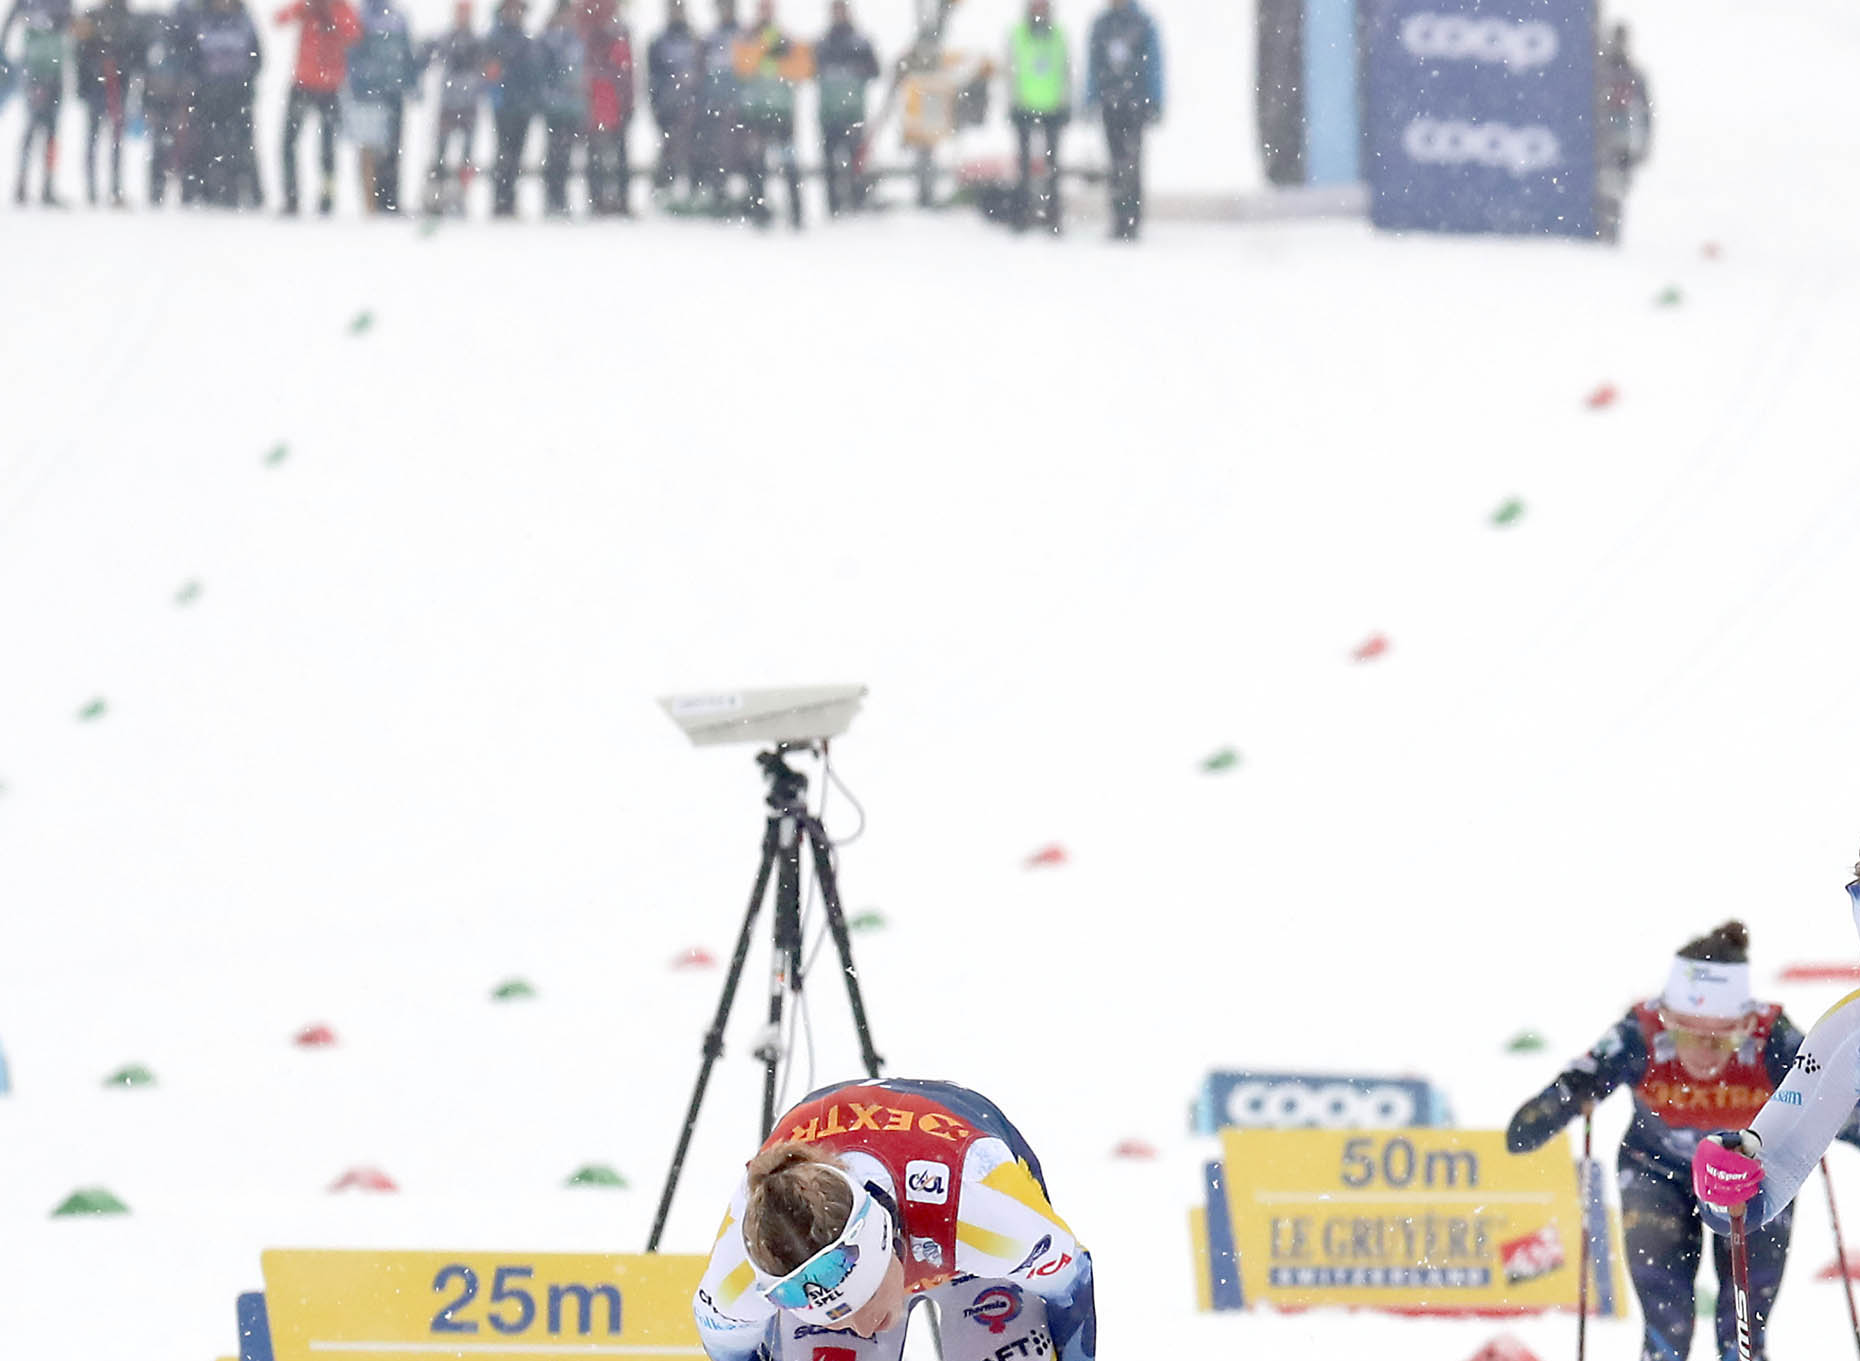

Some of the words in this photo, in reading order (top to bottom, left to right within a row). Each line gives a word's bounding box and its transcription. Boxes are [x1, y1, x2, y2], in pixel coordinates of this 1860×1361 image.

[787, 1102, 915, 1145] EXTR
[1226, 1081, 1415, 1128] coop
[1341, 1138, 1479, 1187] 50m
[1270, 1217, 1318, 1260] LE
[430, 1264, 623, 1335] 25m
